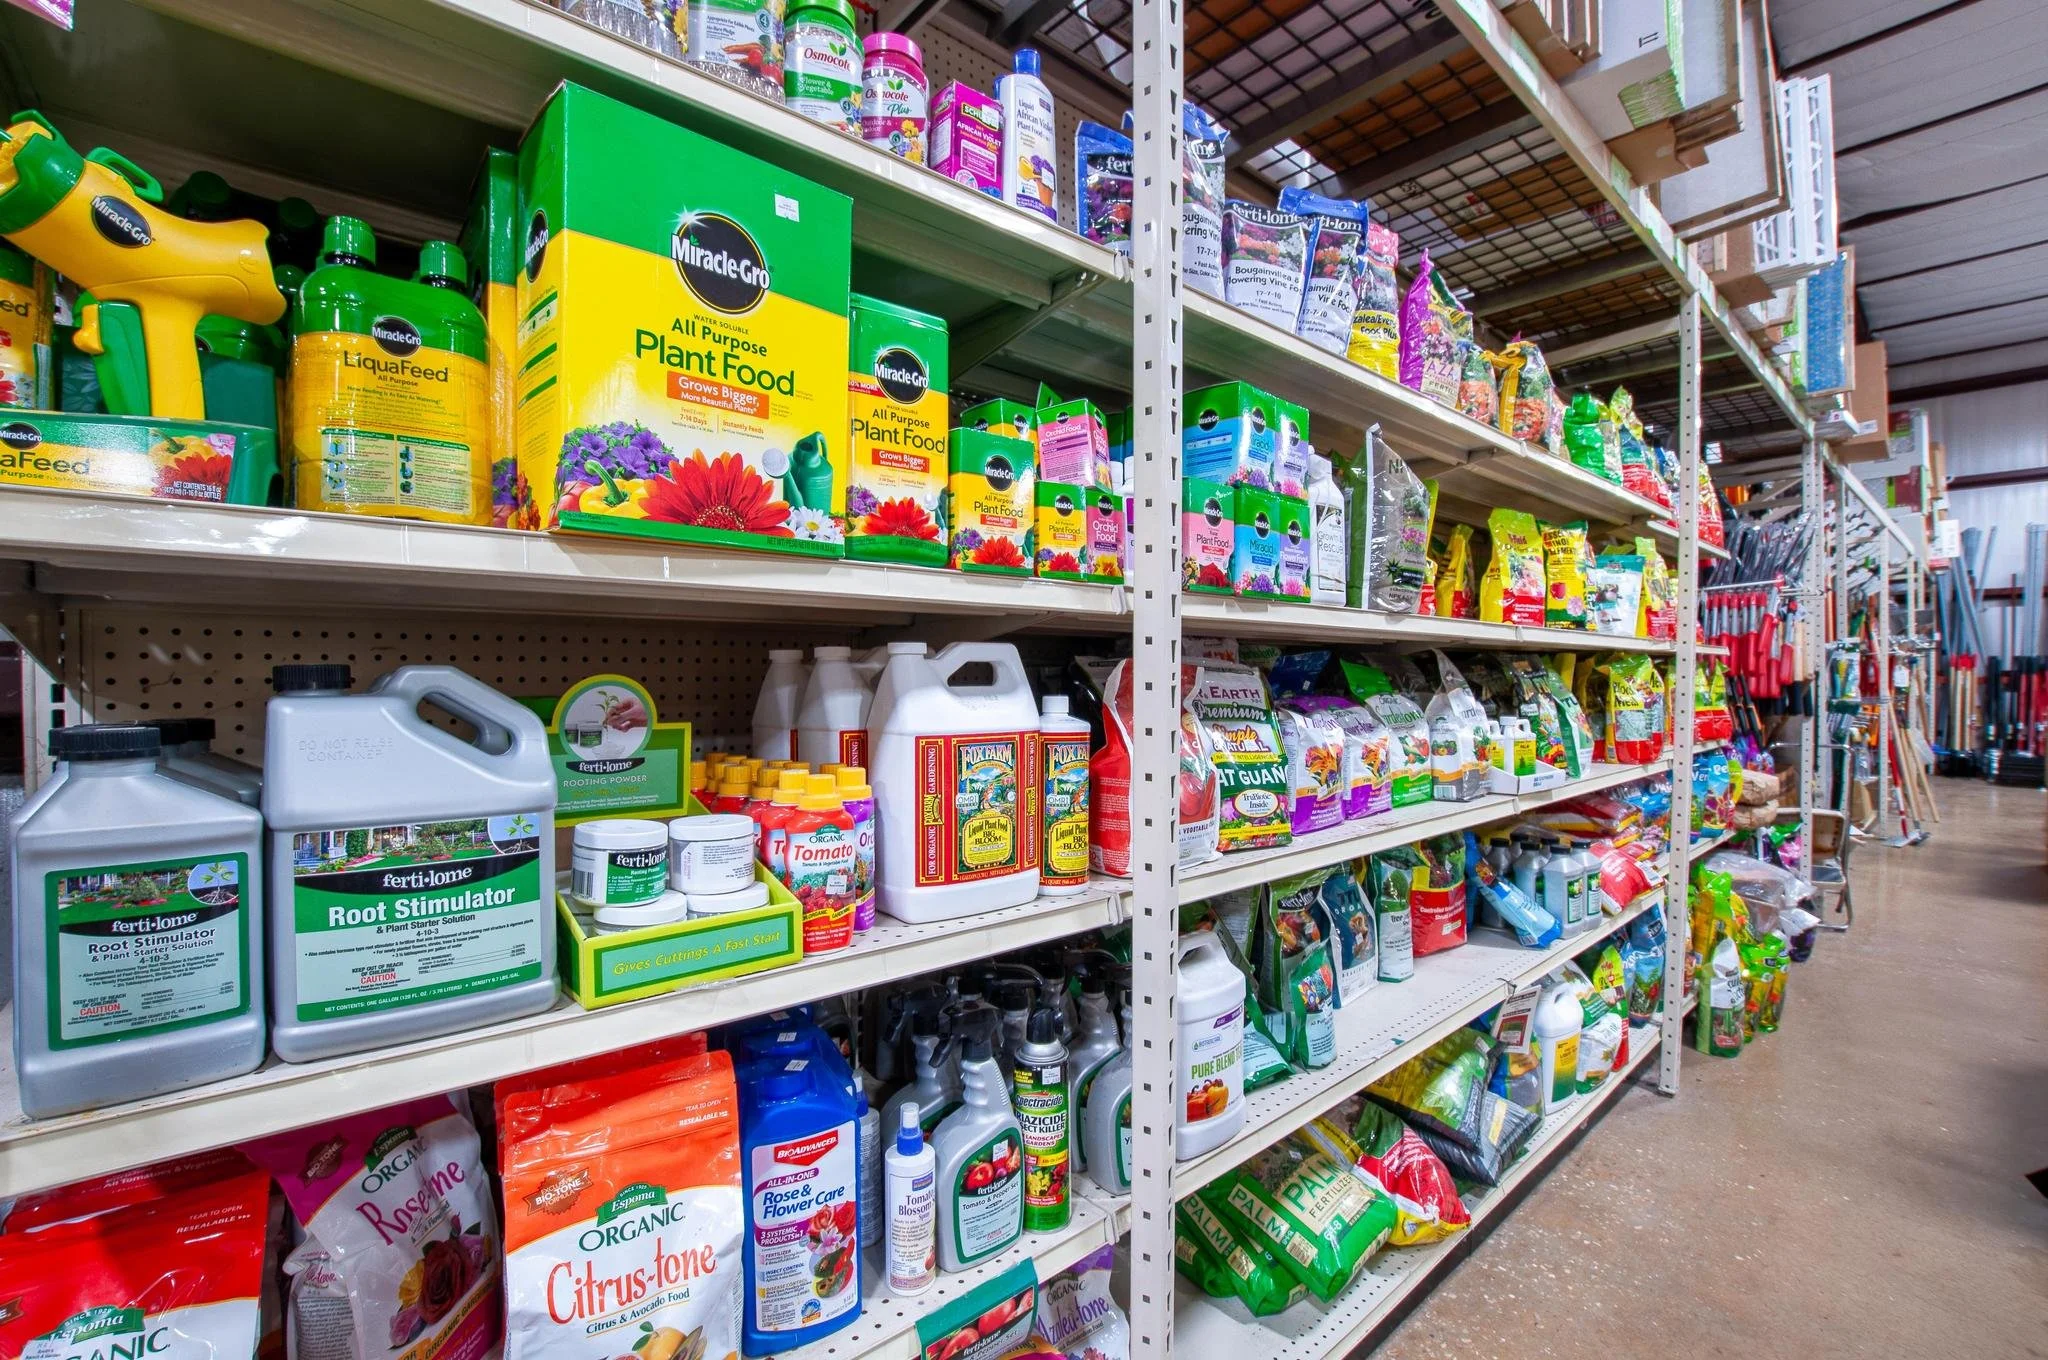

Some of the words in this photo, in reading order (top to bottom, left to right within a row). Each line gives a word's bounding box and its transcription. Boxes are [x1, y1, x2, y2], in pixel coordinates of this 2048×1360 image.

[804, 47, 851, 72] Osmocote
[865, 88, 909, 102] Osocote
[887, 103, 912, 117] Plus
[1017, 109, 1039, 124] African
[957, 121, 982, 136] AFRICAN
[983, 132, 1002, 147] VIOLET
[1017, 121, 1031, 133] Plant
[91, 196, 151, 246] Miracle-Gro
[671, 233, 771, 291] Miracle-Gro
[1235, 266, 1292, 283] Bougainvillea
[1269, 278, 1288, 290] Vine
[1256, 290, 1282, 300] 17-7-10
[694, 313, 718, 327] WATER
[719, 320, 749, 336] SOLUBLE
[372, 326, 422, 346] Miracle-Gro
[671, 318, 697, 337] All
[702, 325, 768, 357] Purpose
[343, 350, 449, 383] LiquaFeed
[636, 328, 716, 378] Plant
[723, 352, 795, 398] Food
[378, 375, 388, 384] All
[390, 377, 418, 388] Purpose
[874, 362, 929, 389] Miracle-Gro
[679, 375, 719, 397] Grows
[721, 383, 760, 408] Bigger,
[681, 391, 700, 403] More
[701, 394, 733, 411] Beautiful
[693, 416, 708, 427] Days
[873, 408, 887, 421] All
[890, 412, 930, 429] Purpose
[723, 418, 748, 432] Instantly
[749, 424, 764, 435] Feeds
[1046, 427, 1066, 438] Orchid
[1065, 425, 1082, 433] Food
[0, 430, 42, 442] Miracle-Gro
[851, 418, 900, 446] Plant
[904, 428, 945, 454] Food
[880, 451, 902, 462] Grows
[0, 469, 44, 480] Purpose
[984, 466, 1015, 480] Miracle-Gro
[974, 501, 999, 515] Plant
[1000, 504, 1024, 518] Food
[1049, 525, 1065, 535] Plant
[1065, 527, 1081, 535] Food
[1093, 521, 1119, 534] Orchid
[1096, 531, 1117, 542] Food
[1197, 534, 1213, 546] Plant
[1213, 536, 1230, 548] Food
[1210, 686, 1261, 700] EARTH
[1192, 701, 1267, 722] Premium
[984, 743, 1014, 763] FARM
[928, 748, 937, 793] GARDENING
[563, 777, 608, 788] ROOTING
[609, 774, 648, 785] POWDER
[957, 796, 977, 804] OMRI
[1048, 796, 1070, 804] OMRI
[1249, 800, 1269, 809] Inside
[968, 821, 984, 838] Liquid
[984, 819, 998, 831] Plant
[998, 819, 1008, 832] Food
[983, 830, 996, 839] BIG
[1056, 825, 1075, 842] Liquid
[1183, 824, 1209, 834] VEGETABLE
[809, 833, 845, 844] ORGANIC
[928, 826, 937, 860] ORGANIC
[975, 836, 1001, 845] BLOOM
[1073, 835, 1086, 843] BIG
[793, 844, 854, 862] Tomato
[928, 860, 937, 876] FOR
[328, 901, 387, 928] Root
[395, 886, 517, 920] Stimulator
[376, 925, 385, 935] &
[385, 922, 409, 934] Plant
[409, 919, 441, 931] Starter
[442, 913, 476, 927] Solution
[416, 928, 439, 937] 4-10-3
[88, 940, 129, 956] Root
[134, 927, 216, 949] Stimulator
[91, 955, 99, 963] &
[103, 951, 130, 962] Plant
[133, 946, 169, 958] Starter
[172, 939, 214, 952] Solution
[613, 958, 652, 976] Gives
[654, 945, 710, 967] Cuttings
[712, 943, 722, 955] A
[724, 937, 750, 953] Fast
[752, 931, 782, 947] Start
[139, 953, 170, 965] 4-10-3
[386, 961, 404, 969] REACH
[360, 972, 397, 984] CAUTION
[369, 968, 395, 976] CHILDREN
[108, 993, 127, 1001] REACH
[378, 996, 400, 1005] GALLON
[80, 1003, 121, 1017] CAUTION
[1191, 1061, 1214, 1080] PURE
[1216, 1050, 1235, 1072] BLEND
[706, 1098, 721, 1108] OPEN
[1015, 1095, 1063, 1109] Spectracide
[679, 1112, 718, 1127] RESEALABLE
[1040, 1121, 1065, 1133] KILLER
[1025, 1133, 1063, 1142] LANDSCAPES
[1025, 1140, 1056, 1148] GARDENS
[307, 1142, 345, 1178] BIO-TONE
[767, 1170, 816, 1189] ALL-IN-ONE
[535, 1178, 584, 1206] BIO-TONE
[619, 1185, 635, 1198] SINCE
[763, 1189, 800, 1206] Rose
[801, 1184, 812, 1197] &
[962, 1199, 986, 1211] Tomato
[992, 1186, 1011, 1201] Pepper
[611, 1191, 656, 1213] Espoma
[763, 1198, 814, 1220] Flower
[815, 1186, 846, 1206] Care
[898, 1202, 932, 1217] Blossom
[189, 1212, 208, 1221] TEAR
[209, 1209, 220, 1218] TO
[221, 1204, 243, 1216] OPEN
[1232, 1187, 1286, 1239] PALM
[176, 1214, 236, 1234] RESEALABLE
[578, 1202, 686, 1253] ORGANIC
[1185, 1197, 1230, 1249] PALM
[766, 1225, 798, 1238] SYSTEMIC
[760, 1234, 795, 1247] PRODUCTS
[765, 1249, 792, 1259] FERTILIZER
[765, 1268, 782, 1277] INSECT
[782, 1263, 805, 1273] CONTROL
[546, 1237, 717, 1326] Citrus-tone
[765, 1283, 786, 1292] DISEASE
[1046, 1279, 1087, 1307] ORGANIC
[64, 1310, 92, 1327] SINCE
[586, 1317, 618, 1335] Citrus
[619, 1312, 628, 1325] &
[629, 1297, 667, 1321] Avocado
[667, 1288, 691, 1304] Food
[49, 1313, 125, 1342] Espoma
